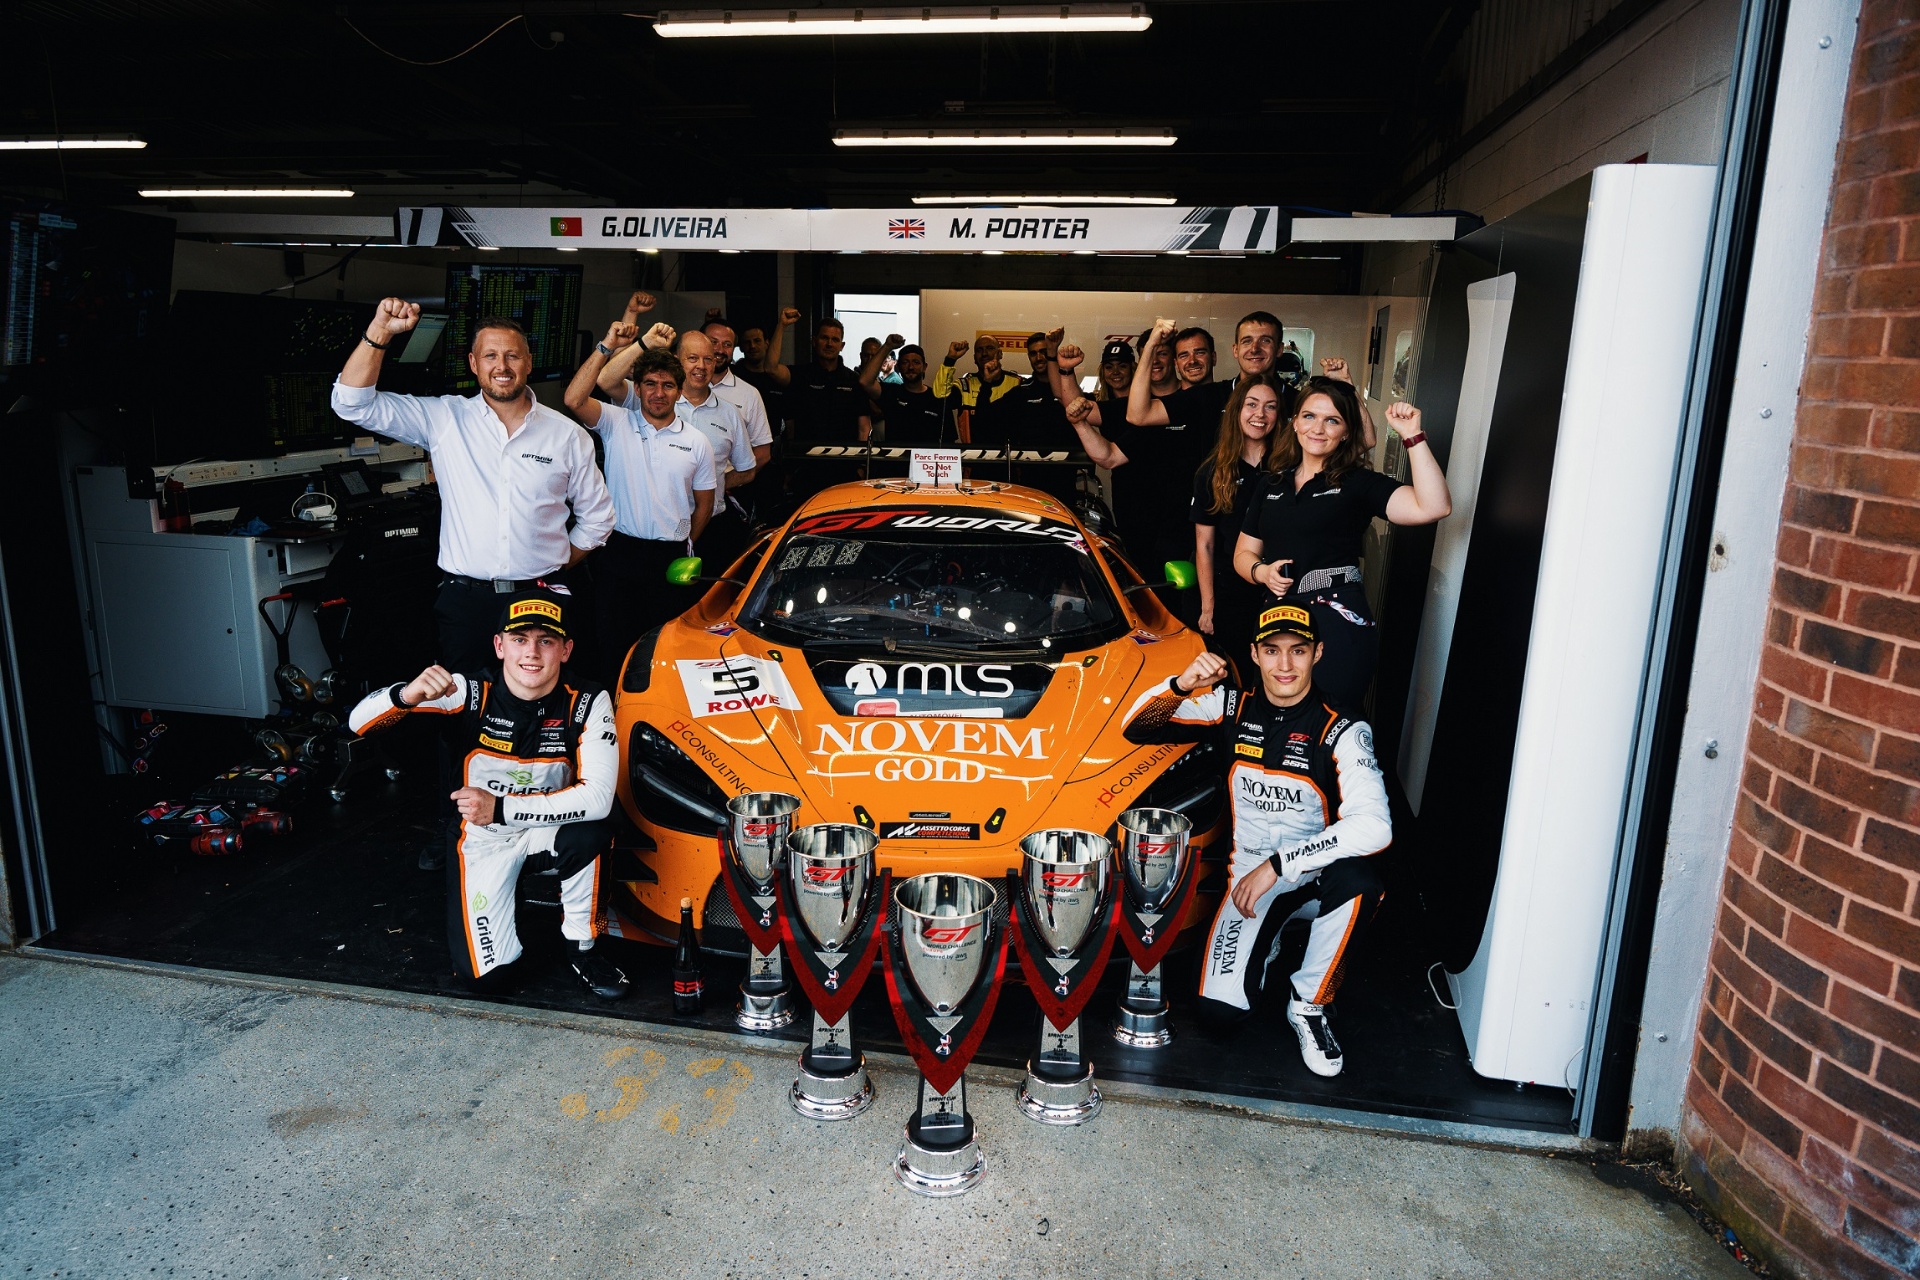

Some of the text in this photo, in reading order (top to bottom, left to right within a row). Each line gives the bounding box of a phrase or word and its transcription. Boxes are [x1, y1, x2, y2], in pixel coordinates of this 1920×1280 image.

[601, 216, 728, 239] G.OLIVEIRA
[949, 217, 1090, 240] M. PORTER
[914, 453, 959, 461] Parc Ferme
[922, 463, 951, 471] Do Not
[713, 666, 760, 696] 5
[574, 692, 592, 723] sparco
[706, 693, 781, 713] ROWE
[812, 719, 1053, 760] NOVEM
[874, 758, 986, 783] GOLD
[1240, 776, 1303, 804] NOVEM
[513, 810, 587, 822] OPTIMUM
[1255, 799, 1287, 813] GOLD
[476, 915, 495, 967] GridFit
[923, 921, 983, 943] GT
[947, 940, 977, 949] CHALLENGE
[1212, 934, 1225, 960] GOLD
[1220, 918, 1244, 976] NOVEM
